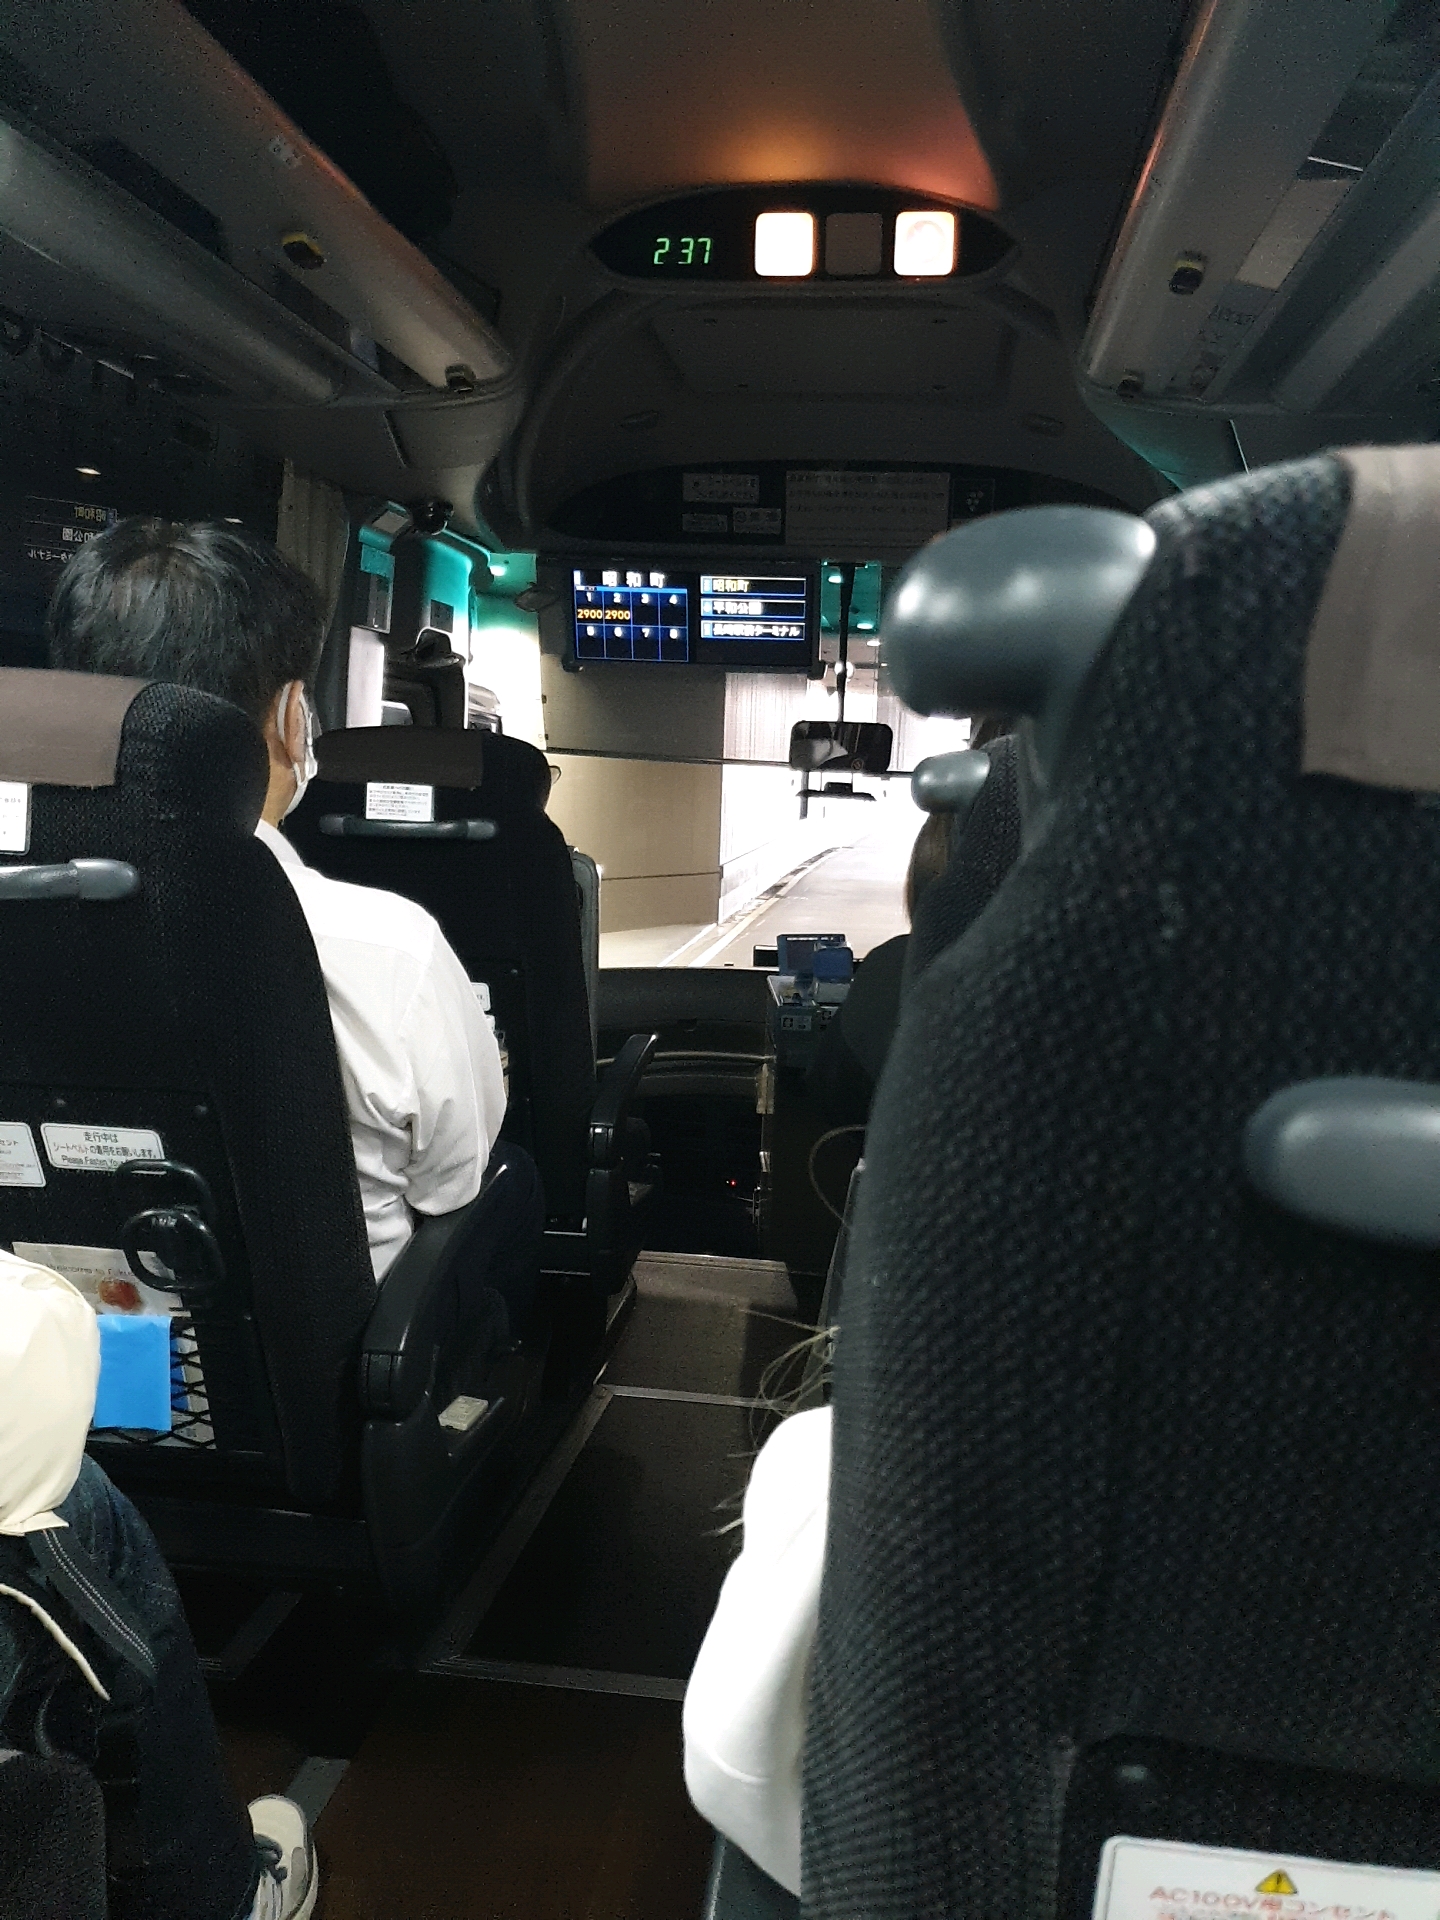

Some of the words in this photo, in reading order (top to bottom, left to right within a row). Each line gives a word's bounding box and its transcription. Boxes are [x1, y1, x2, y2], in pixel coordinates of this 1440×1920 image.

[602, 571, 665, 588] 昭和町
[713, 579, 749, 592] 昭和町
[613, 592, 621, 603] 2
[641, 593, 649, 604] 3
[669, 594, 677, 605] 4
[577, 609, 603, 619] 2900
[605, 610, 631, 620] 2900
[587, 626, 595, 636] 5
[642, 628, 650, 638] 7
[83, 1131, 119, 1143] 走行中は
